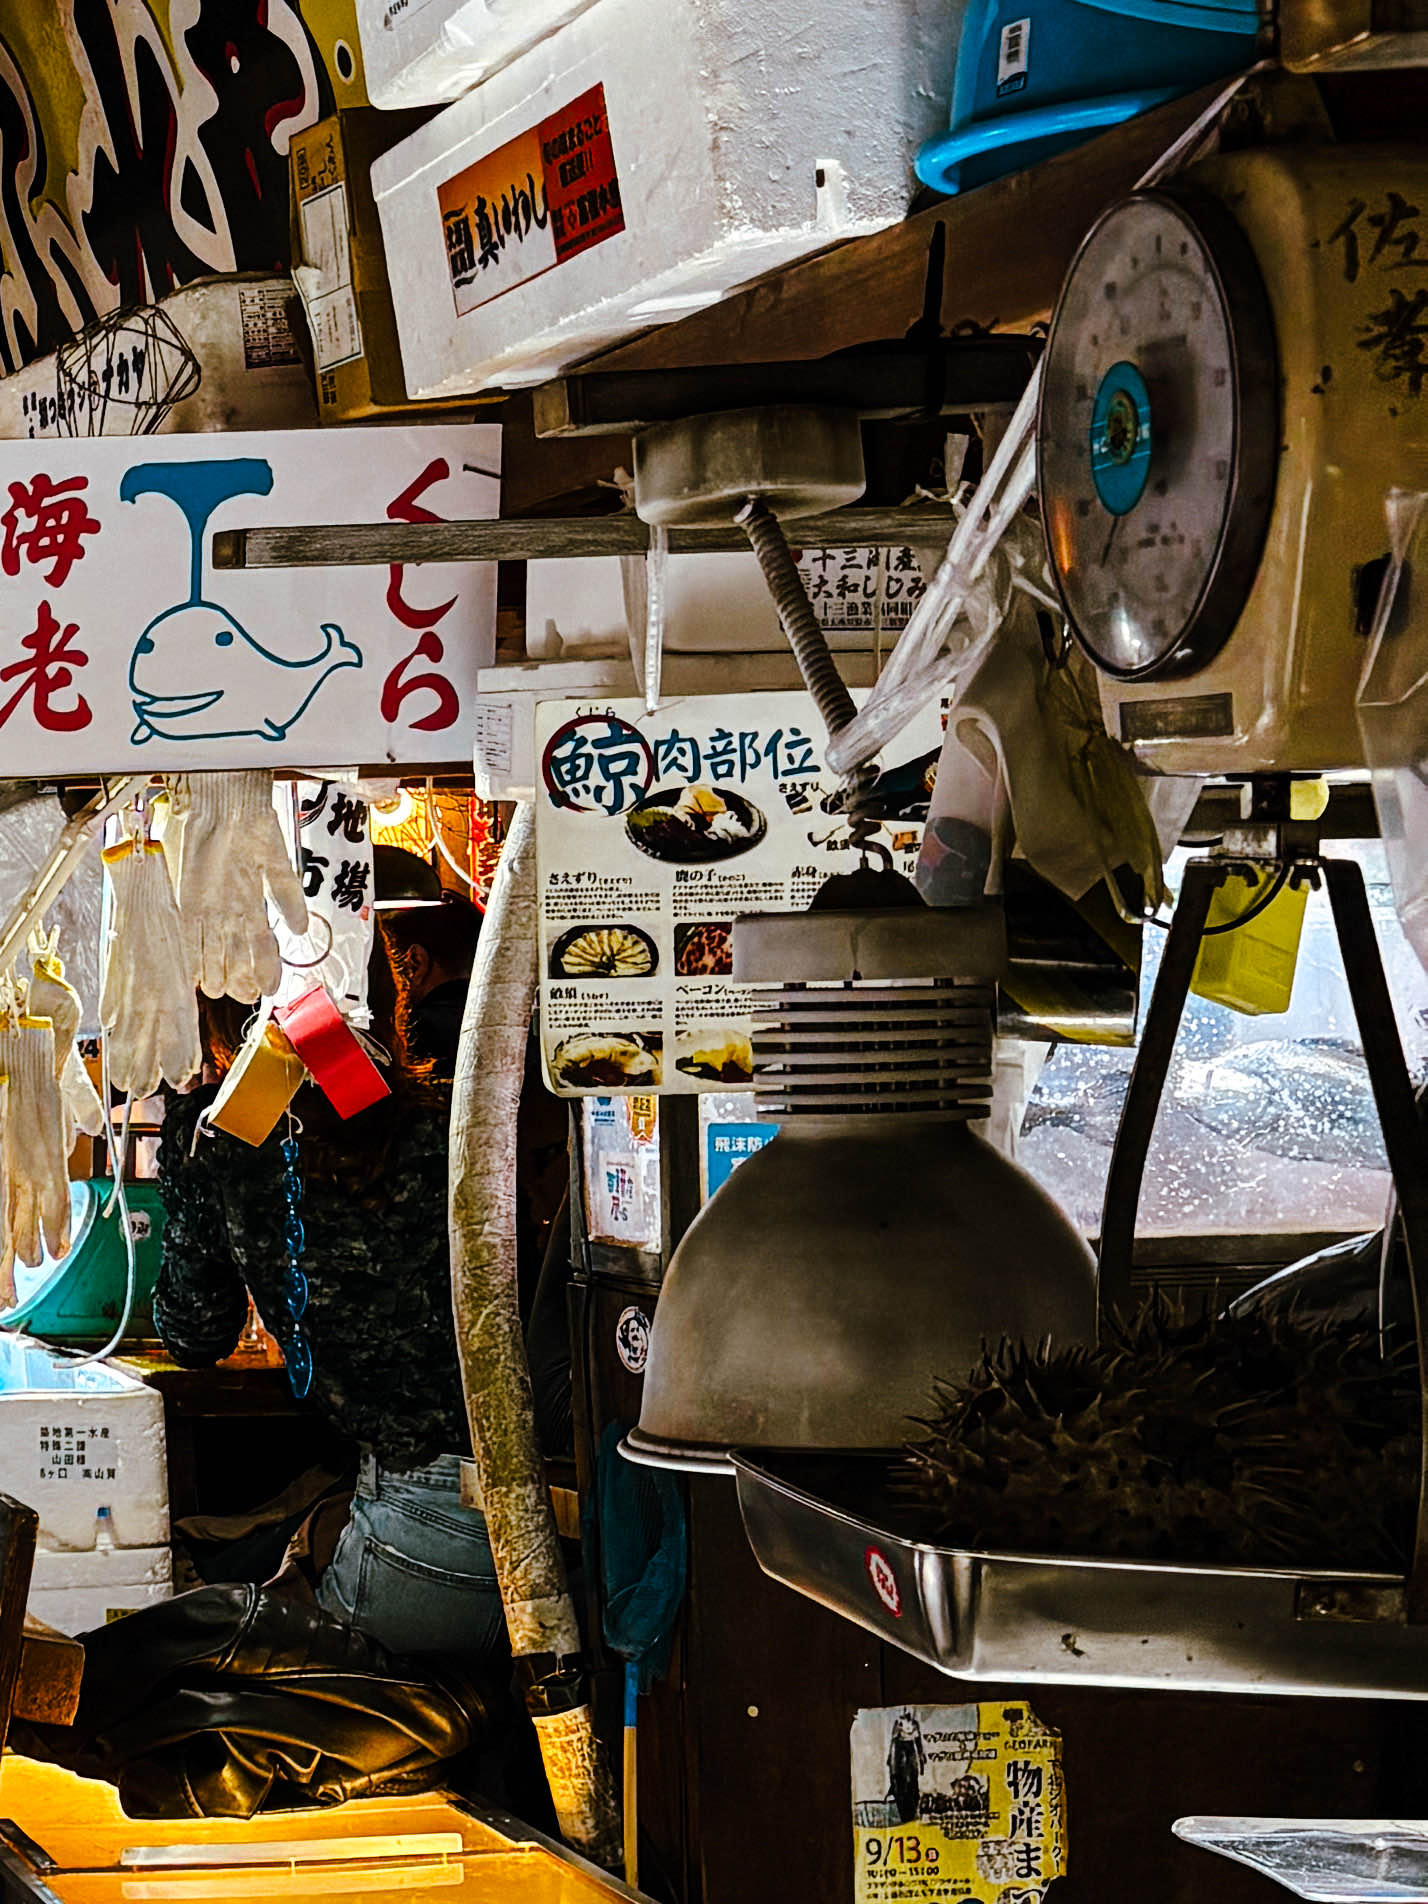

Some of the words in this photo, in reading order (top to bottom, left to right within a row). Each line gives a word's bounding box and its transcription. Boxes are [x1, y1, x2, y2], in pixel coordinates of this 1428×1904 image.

[546, 719, 822, 818] 鯨肉部位
[865, 1835, 922, 1867] 9/13
